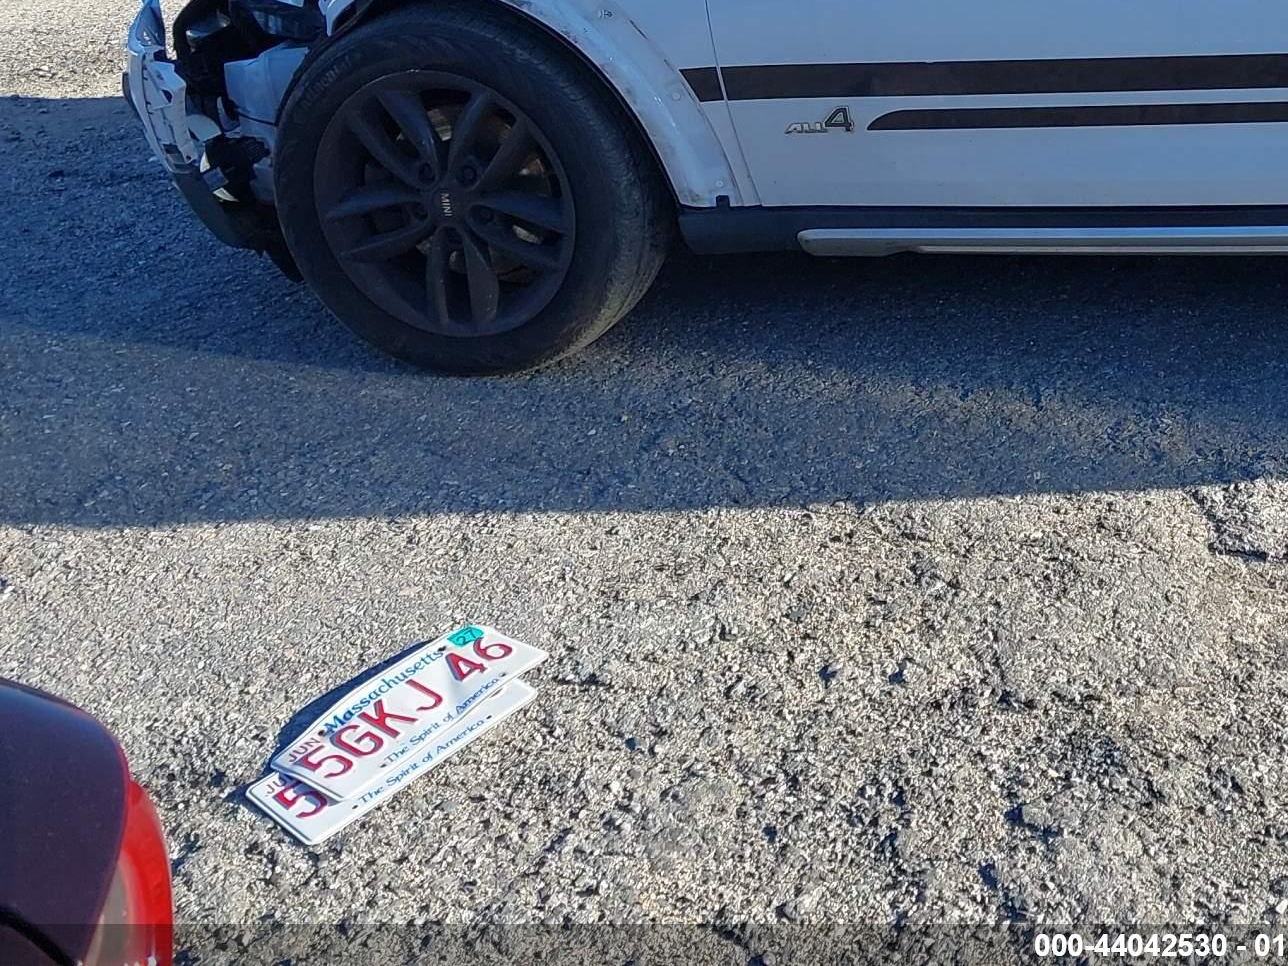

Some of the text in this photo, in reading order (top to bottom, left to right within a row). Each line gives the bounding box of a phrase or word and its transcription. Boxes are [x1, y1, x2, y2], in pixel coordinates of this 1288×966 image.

[440, 193, 453, 217] MINI
[444, 636, 513, 682] 46
[455, 628, 478, 645] 27
[324, 649, 444, 735] Massachusetts
[386, 678, 500, 764] The Spirit of America
[288, 737, 321, 763] JUN
[359, 720, 485, 806] The Spirit of America
